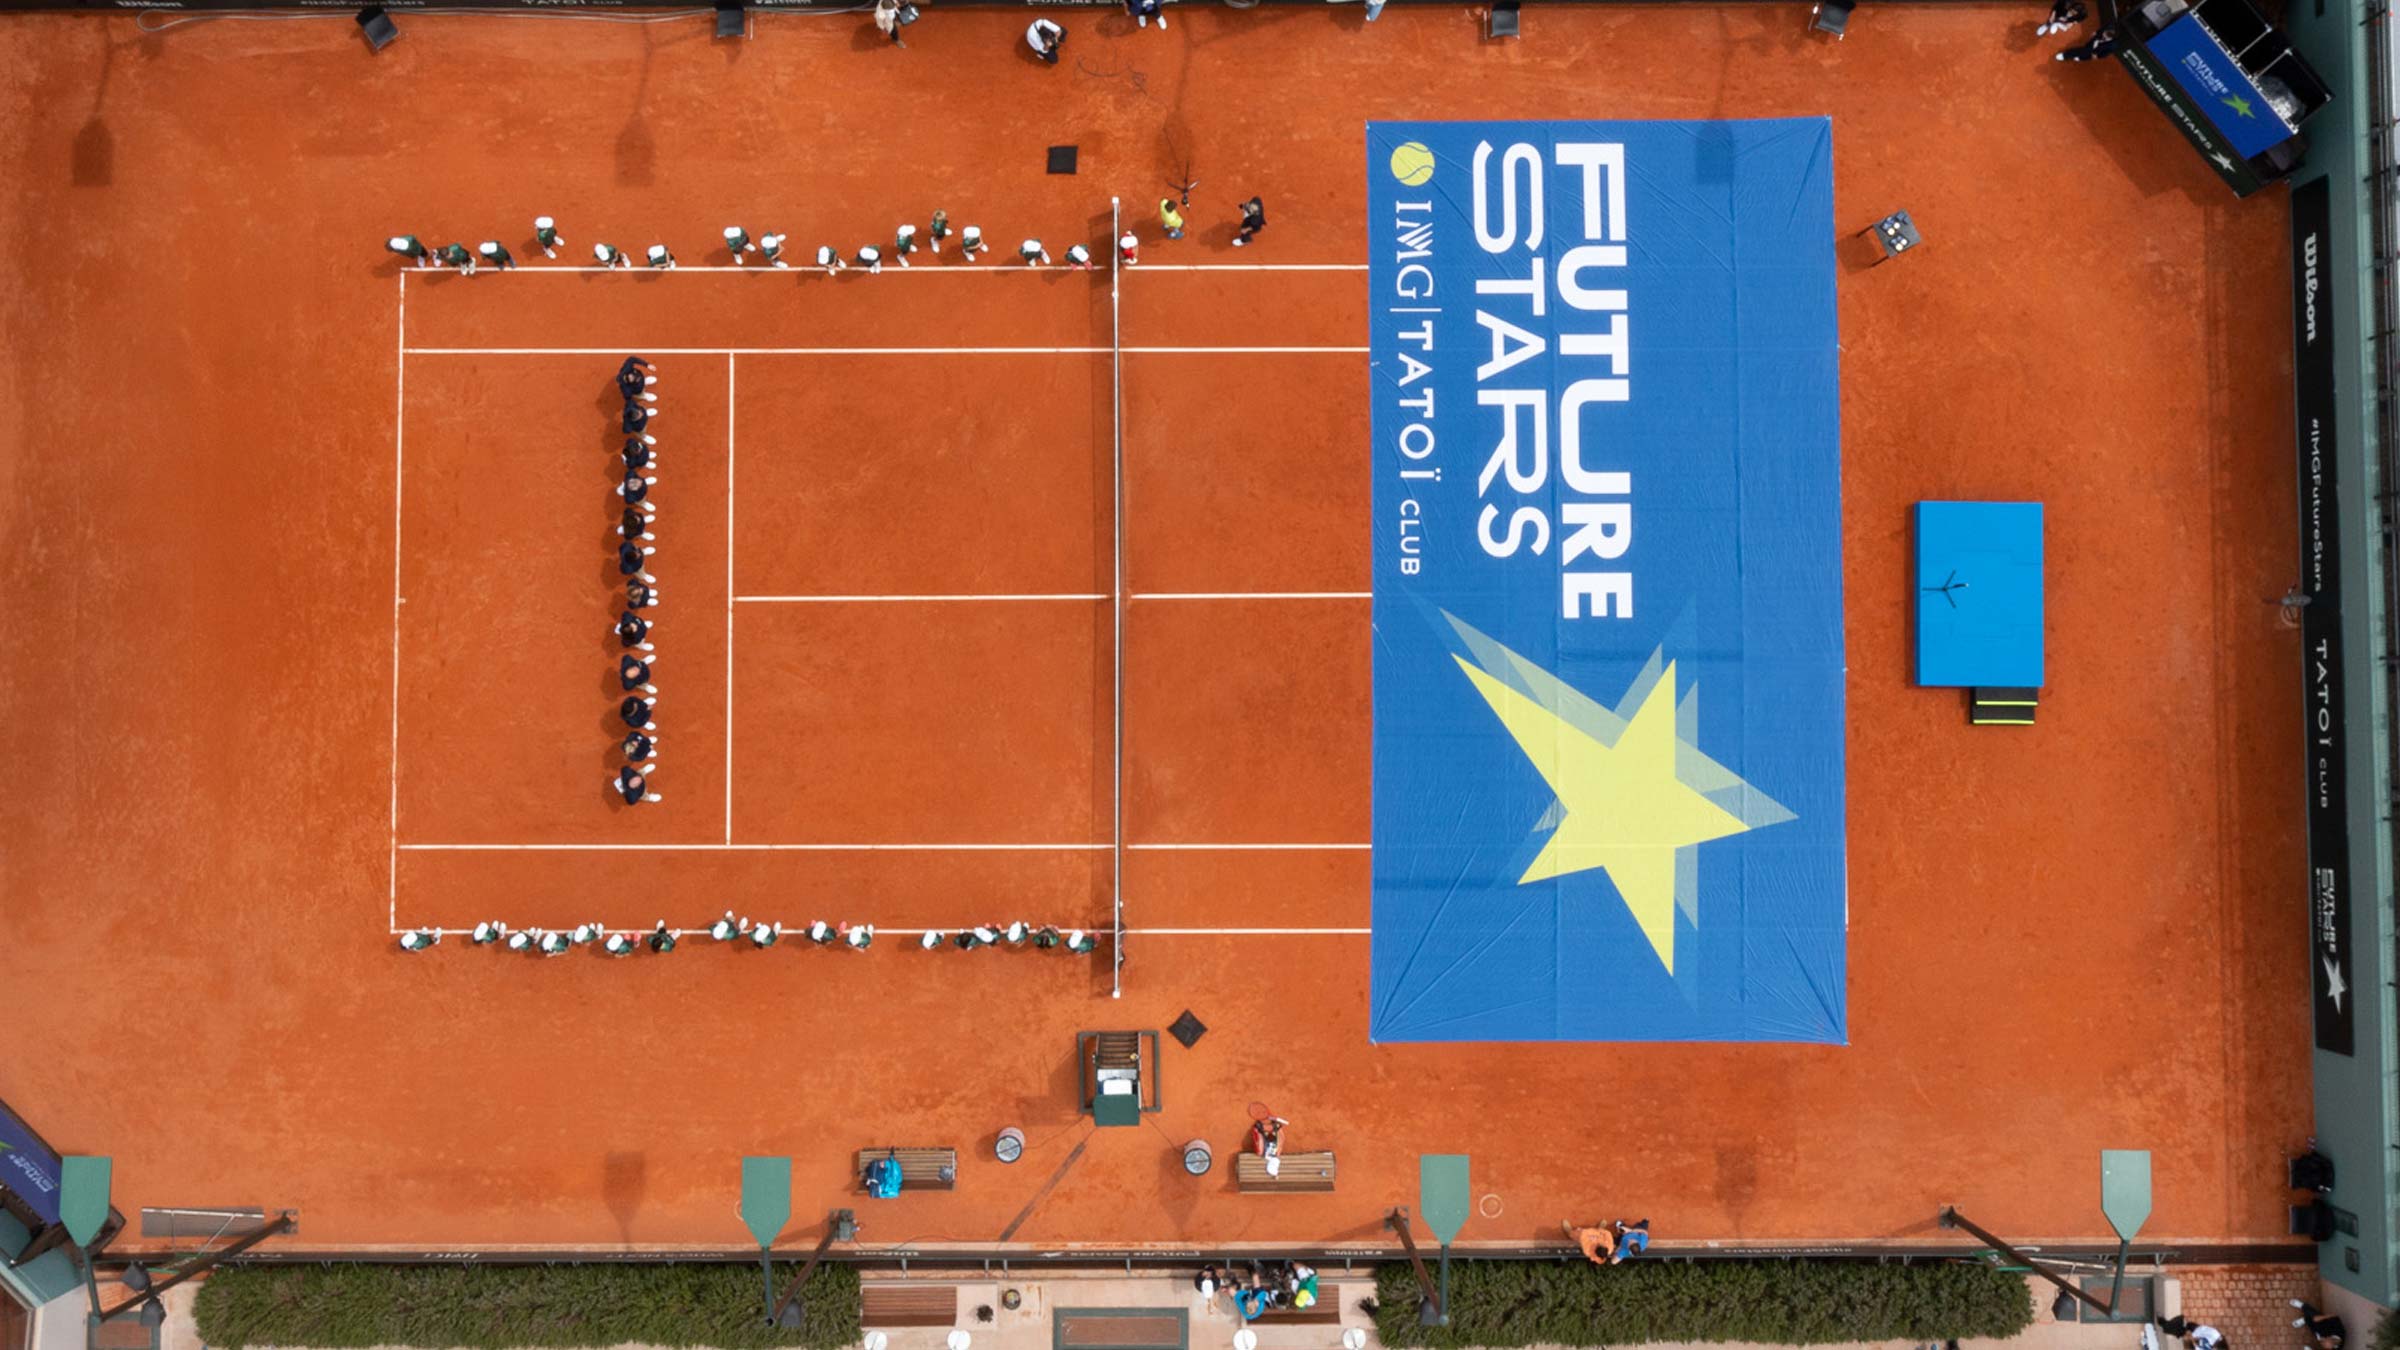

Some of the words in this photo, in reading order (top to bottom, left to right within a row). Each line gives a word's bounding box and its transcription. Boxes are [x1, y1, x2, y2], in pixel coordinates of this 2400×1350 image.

[1396, 200, 1434, 300] IMG
[2304, 231, 2318, 344] Wilson
[1398, 319, 1441, 482] TATOÏ
[1472, 140, 1550, 559] STARS
[1555, 142, 1633, 619] FUTURE
[1400, 498, 1421, 576] CLUB
[2311, 418, 2323, 592] #IMGFutureStars
[2316, 638, 2332, 748] TATOÏ
[2319, 757, 2329, 809] CLUB
